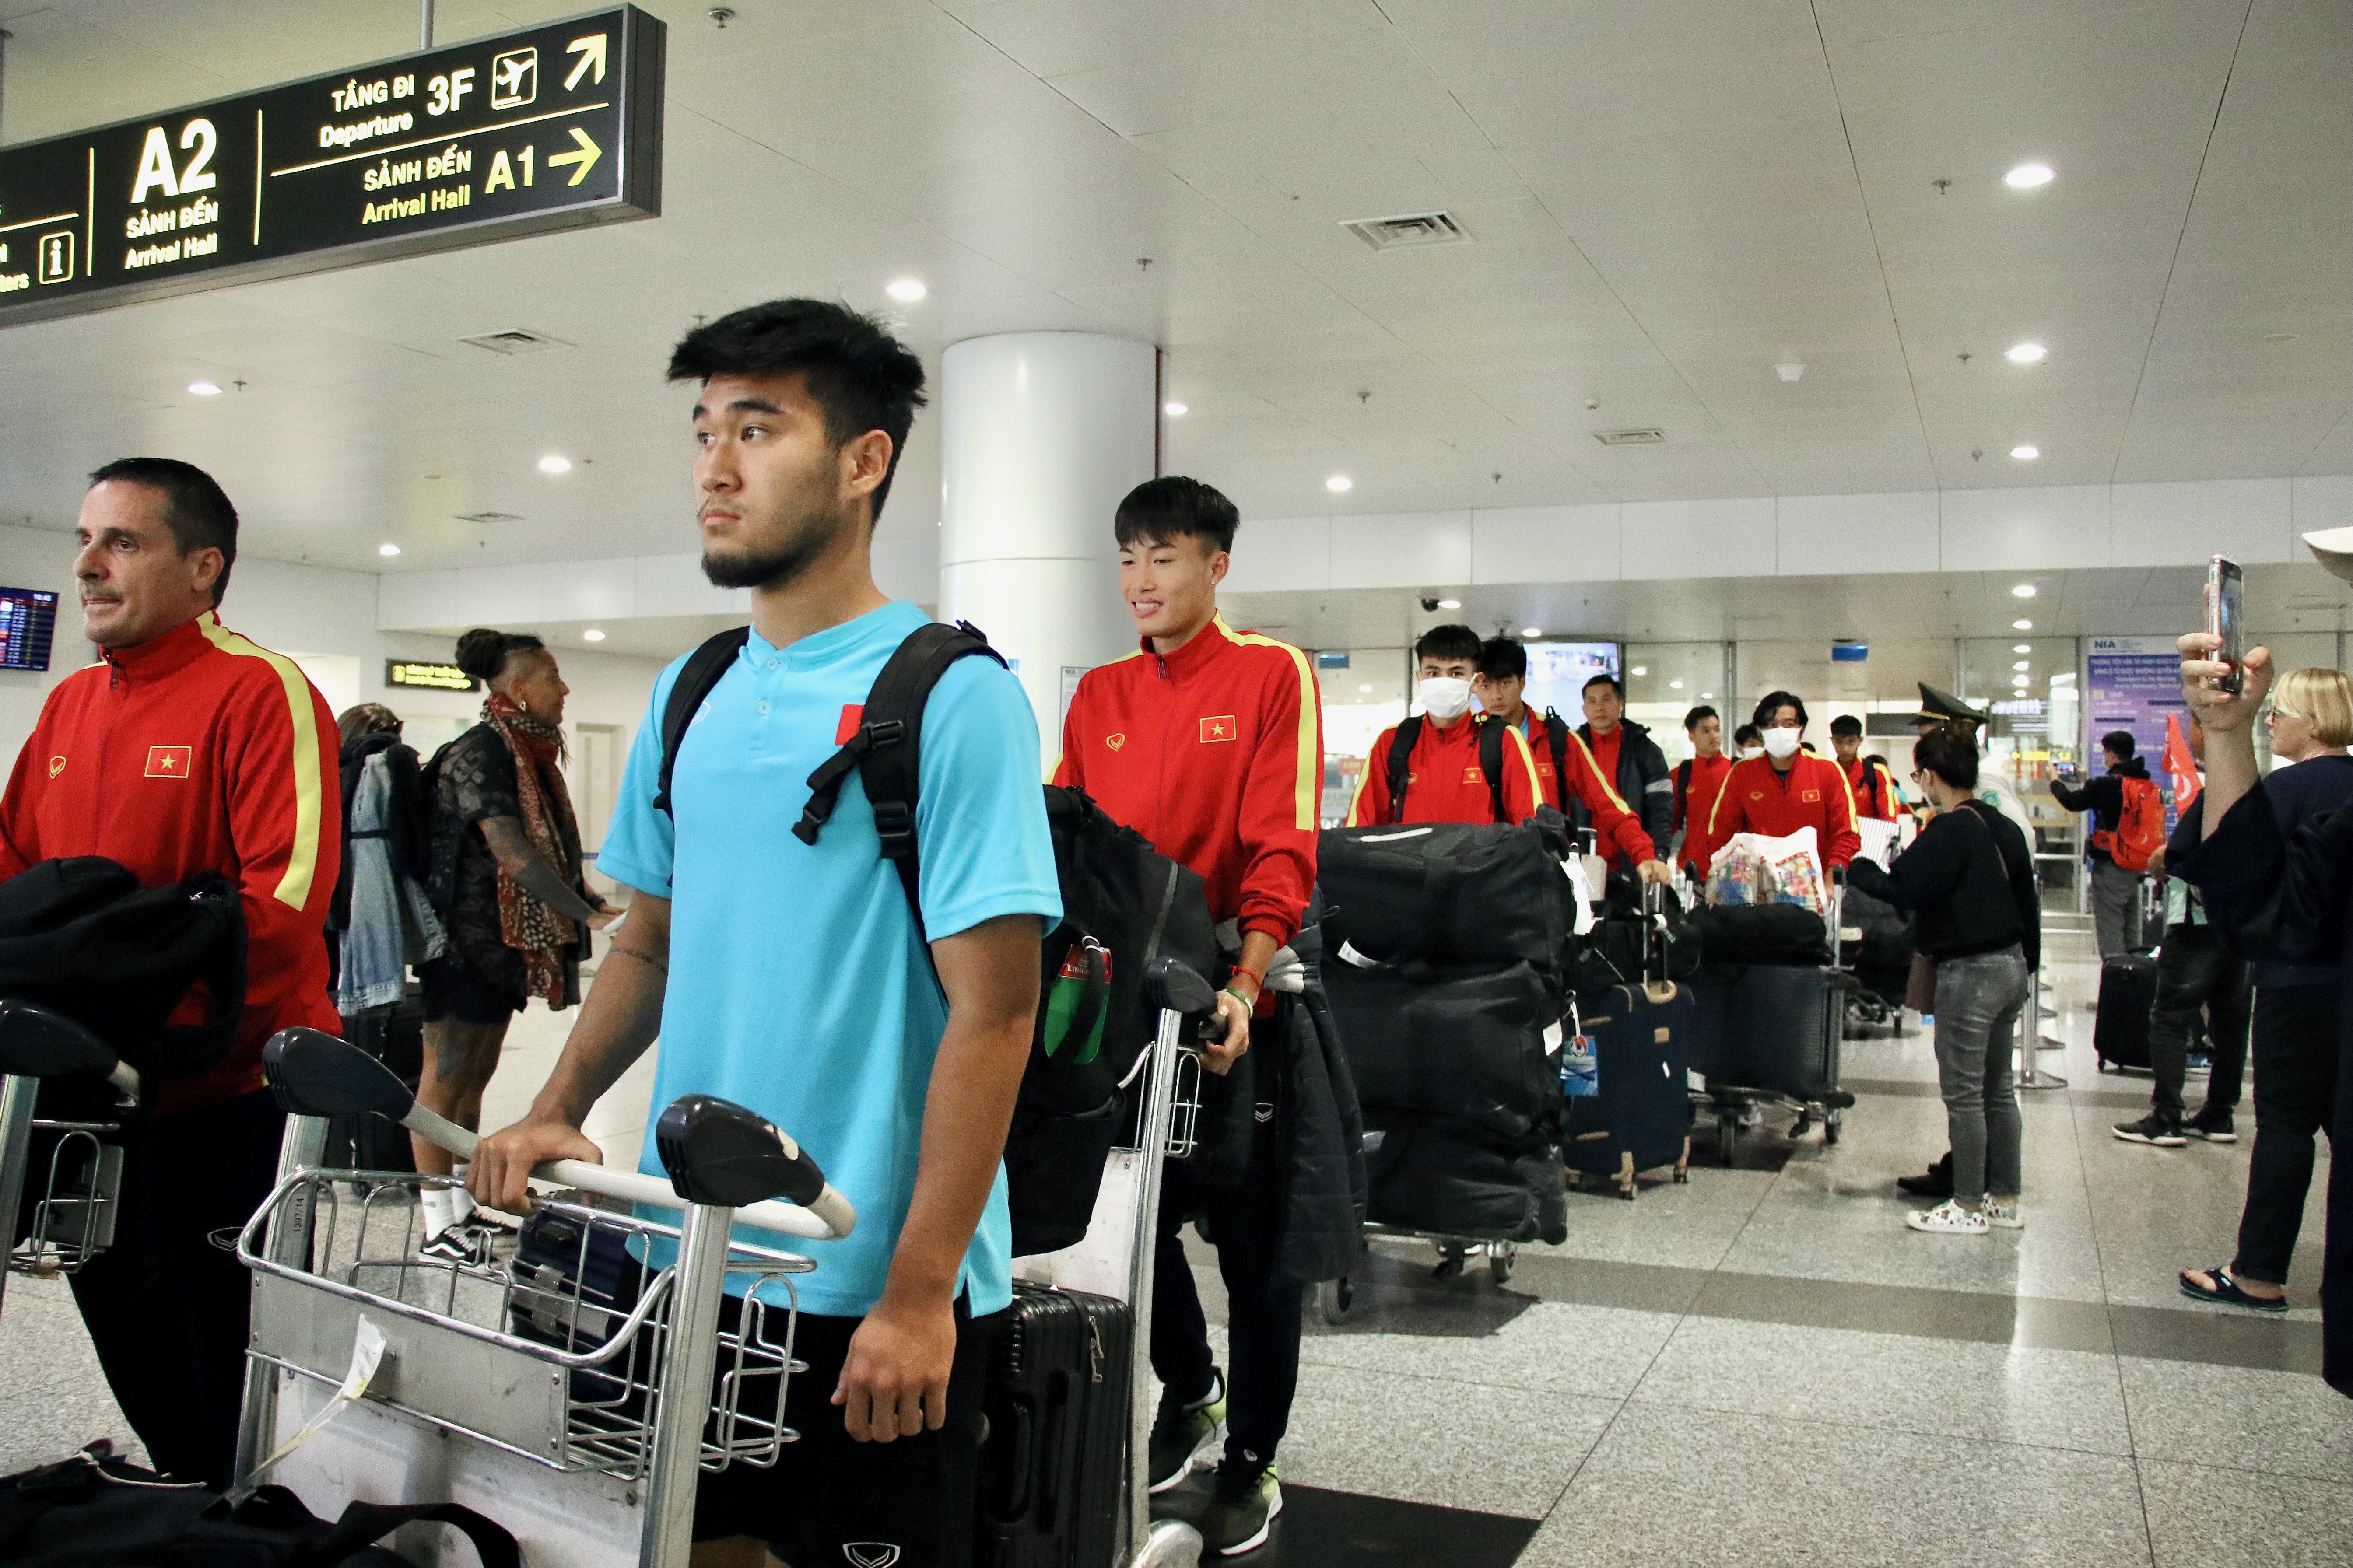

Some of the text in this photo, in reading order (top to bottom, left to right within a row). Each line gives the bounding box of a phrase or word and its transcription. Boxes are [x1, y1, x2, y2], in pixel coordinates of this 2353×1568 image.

[332, 74, 414, 112] TẦNG ĐI
[426, 68, 475, 116] 3F
[319, 112, 413, 148] Departure
[131, 118, 217, 204] A2
[364, 144, 472, 191] SẢNH ĐẾN
[485, 145, 534, 194] A1
[126, 196, 219, 238] SẢNH ĐẾN
[362, 184, 471, 225] Arrival Hall
[124, 232, 218, 270] Arrival Hall
[2094, 640, 2115, 648] NIA
